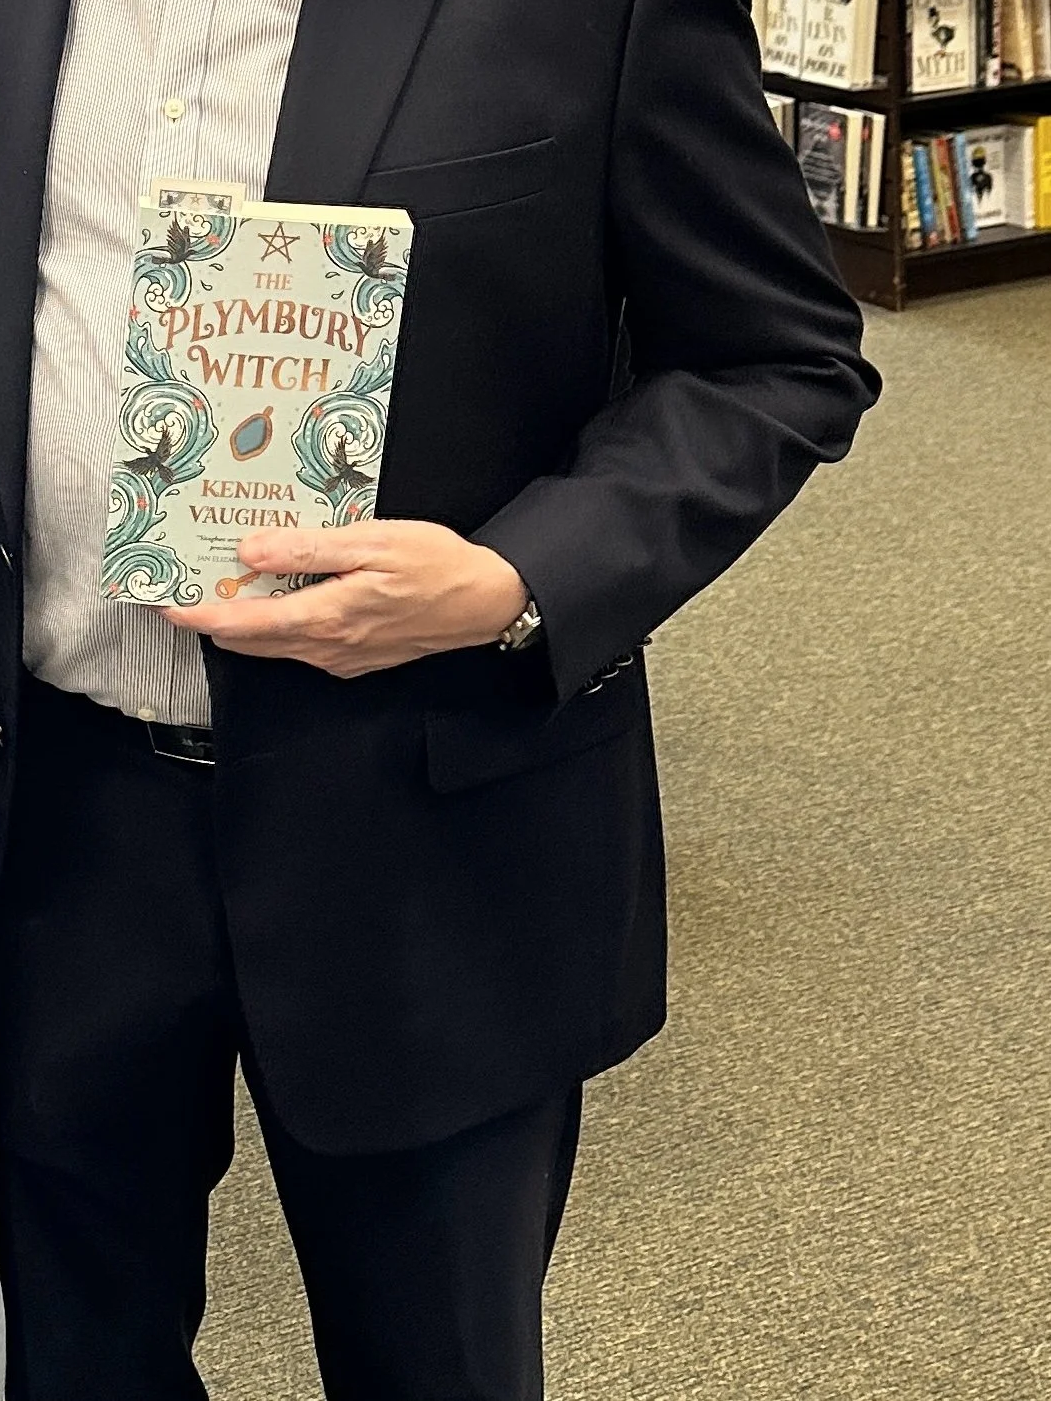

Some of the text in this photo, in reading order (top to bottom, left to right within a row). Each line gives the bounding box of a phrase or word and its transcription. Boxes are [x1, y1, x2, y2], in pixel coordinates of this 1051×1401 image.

[916, 51, 966, 78] MYTH
[253, 272, 294, 291] THE
[158, 298, 372, 358] PLYMBURY
[187, 344, 331, 392] WITCH
[201, 479, 296, 502] KENDRA
[189, 505, 301, 528] VAUGHAN
[197, 555, 211, 563] JAN
